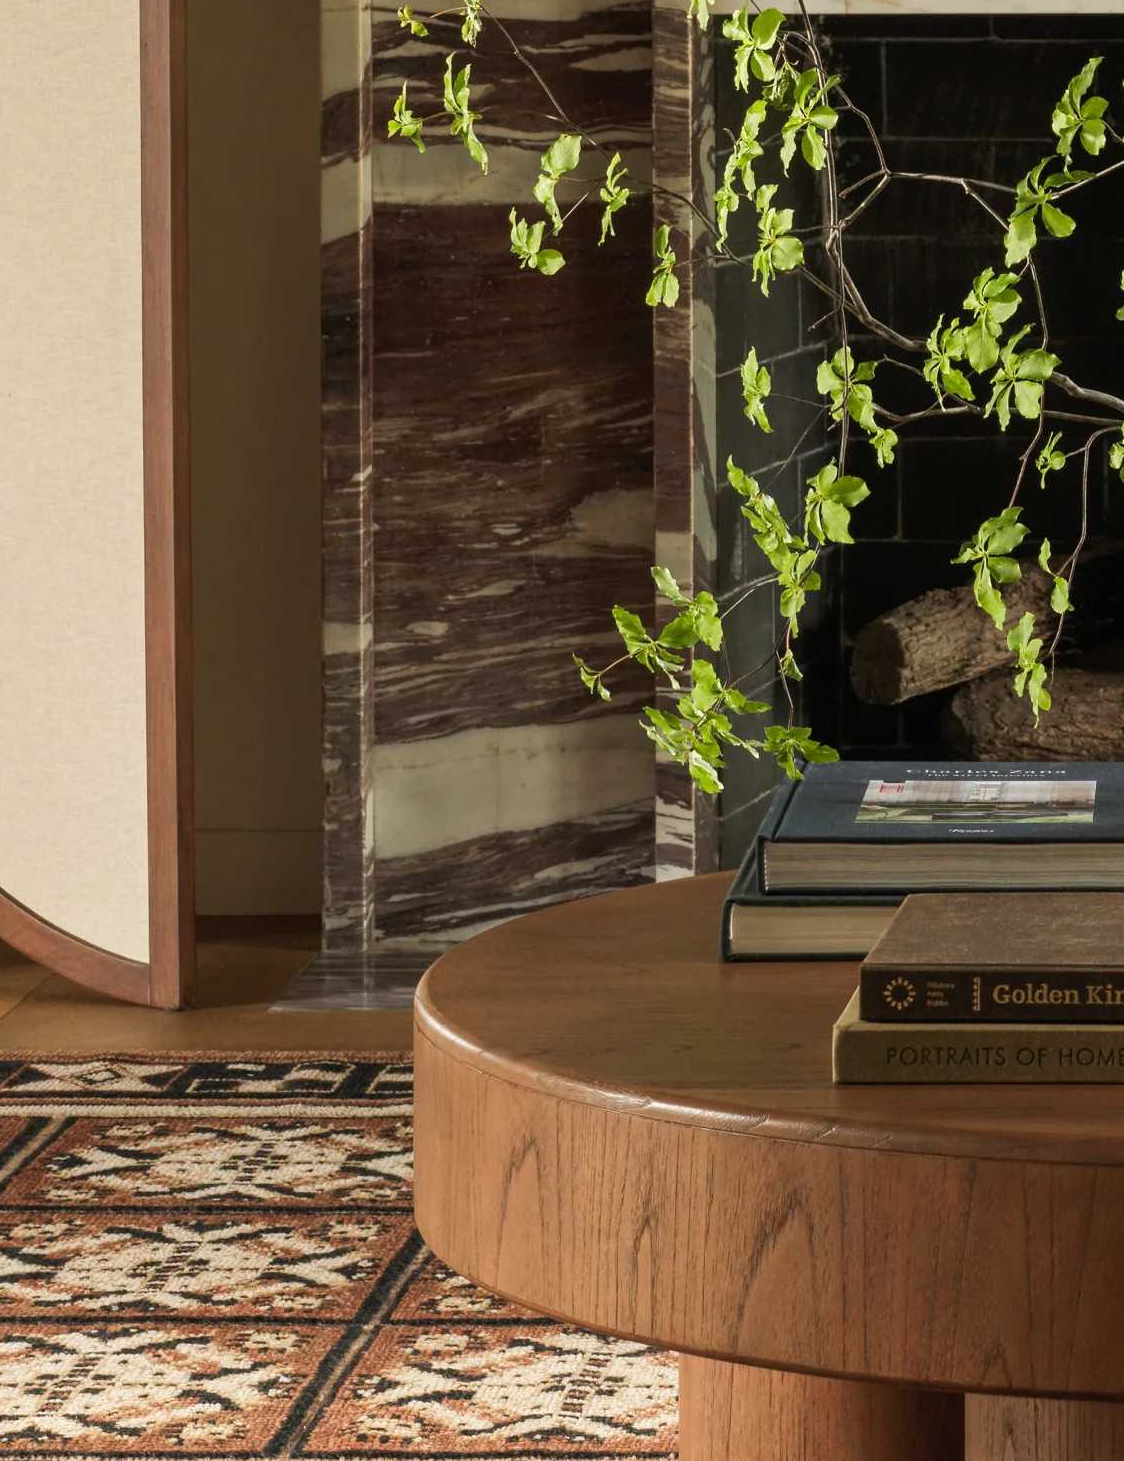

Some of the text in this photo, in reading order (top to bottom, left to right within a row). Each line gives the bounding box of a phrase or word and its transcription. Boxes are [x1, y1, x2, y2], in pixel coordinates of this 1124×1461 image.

[993, 983, 1080, 1004] Golden
[886, 1046, 1006, 1067] PORTRAITS
[1016, 1046, 1048, 1067] OF
